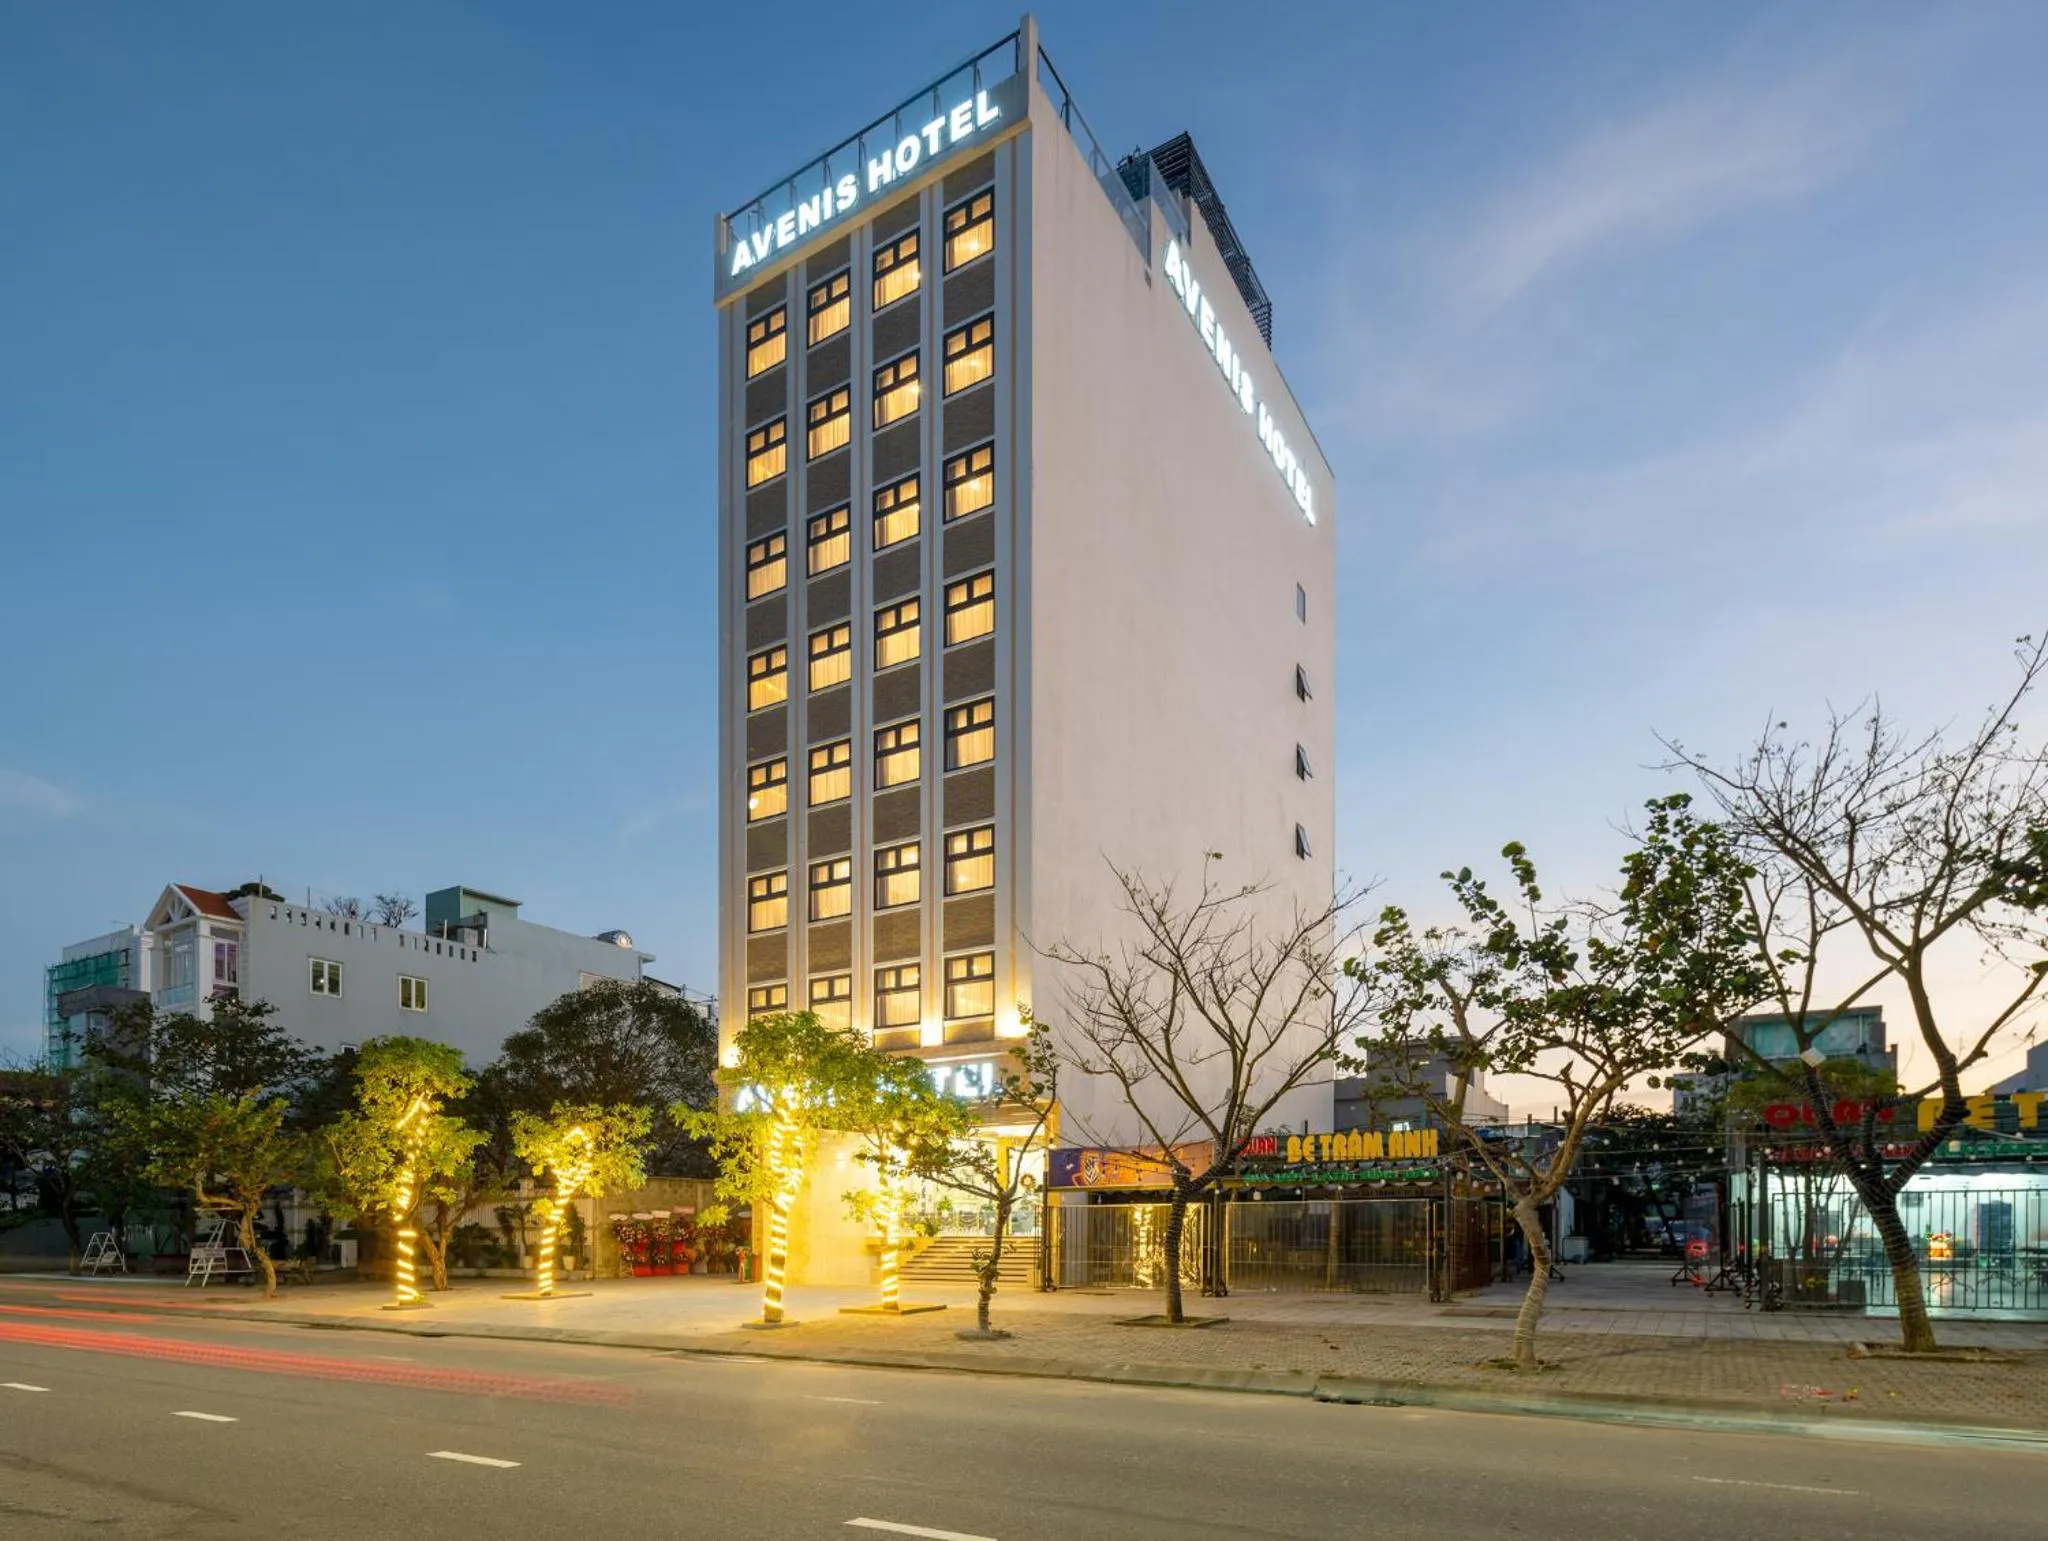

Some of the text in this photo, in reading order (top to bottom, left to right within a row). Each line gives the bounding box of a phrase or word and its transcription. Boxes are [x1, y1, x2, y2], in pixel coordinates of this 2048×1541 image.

[731, 89, 999, 276] AVENIS HOTEL
[1164, 239, 1316, 525] AVENIS HOTEL
[1388, 1128, 1438, 1158] ANH
